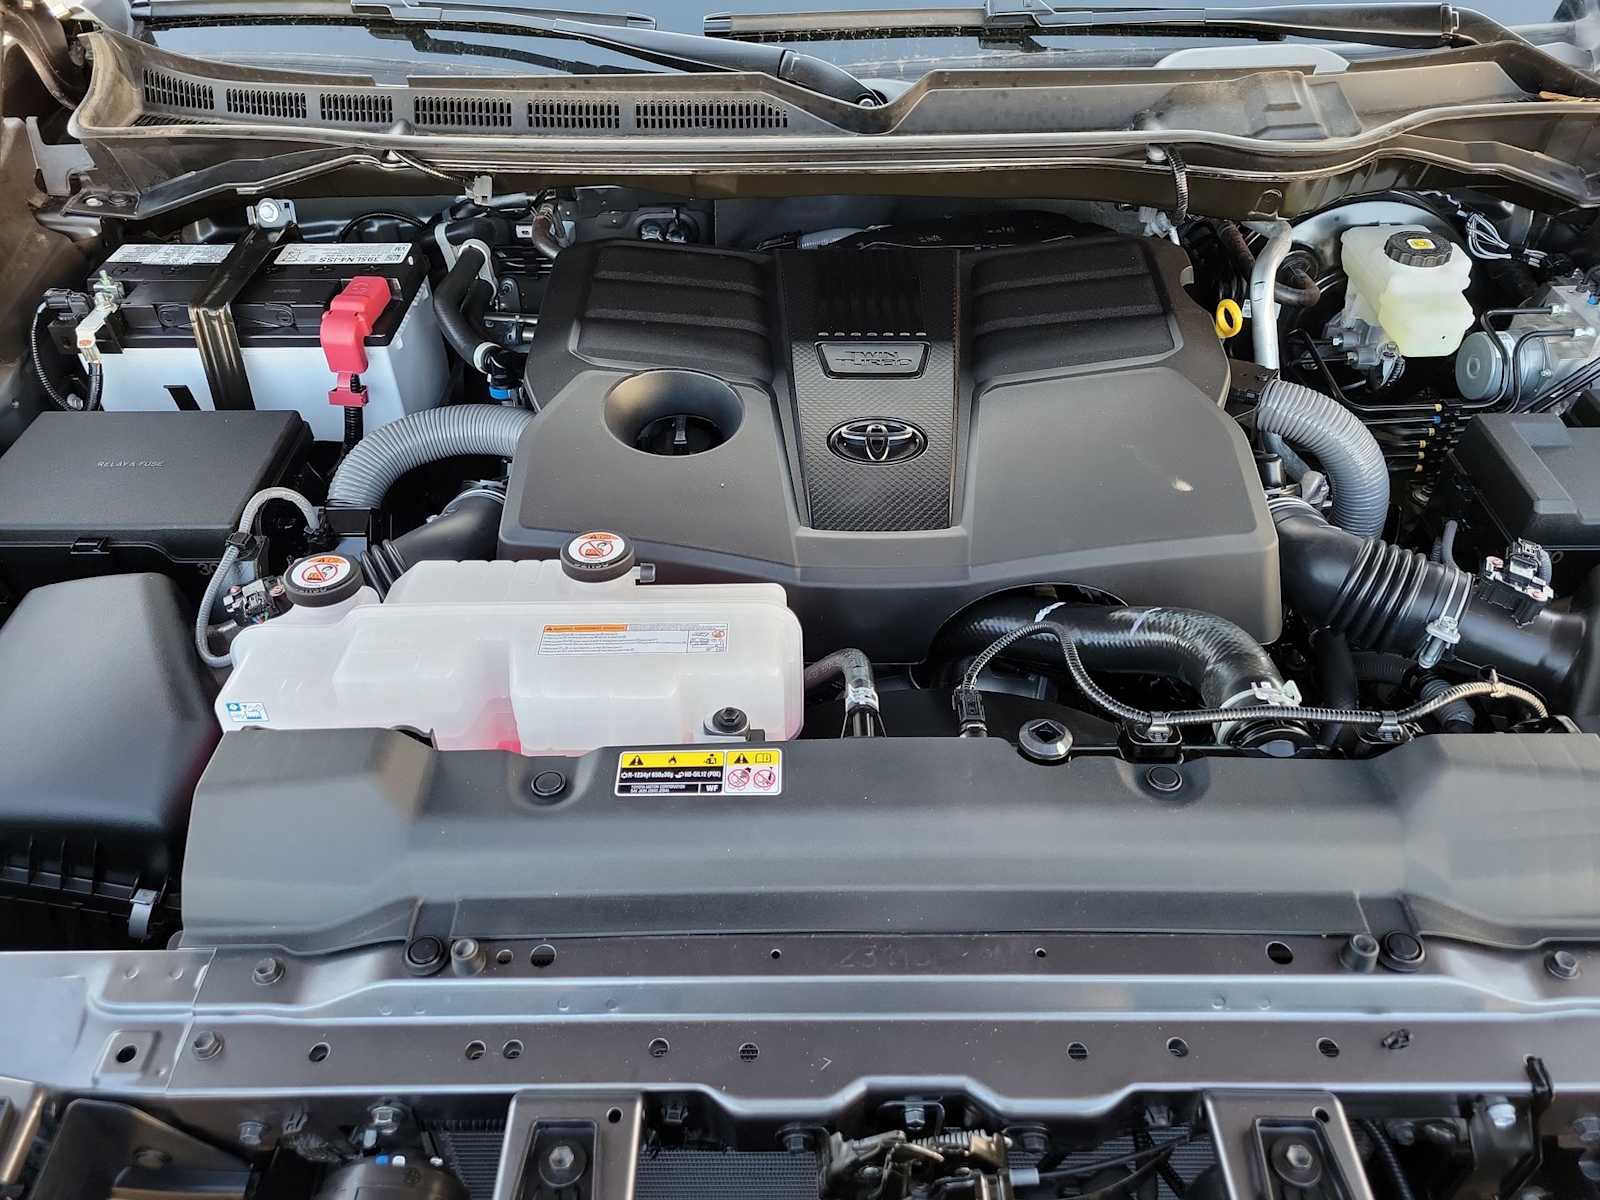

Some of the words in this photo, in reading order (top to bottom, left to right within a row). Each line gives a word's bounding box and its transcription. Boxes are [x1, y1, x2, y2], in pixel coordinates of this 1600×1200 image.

[835, 358, 912, 366] TURBO
[138, 460, 165, 468] FUSE
[705, 784, 719, 792] WF
